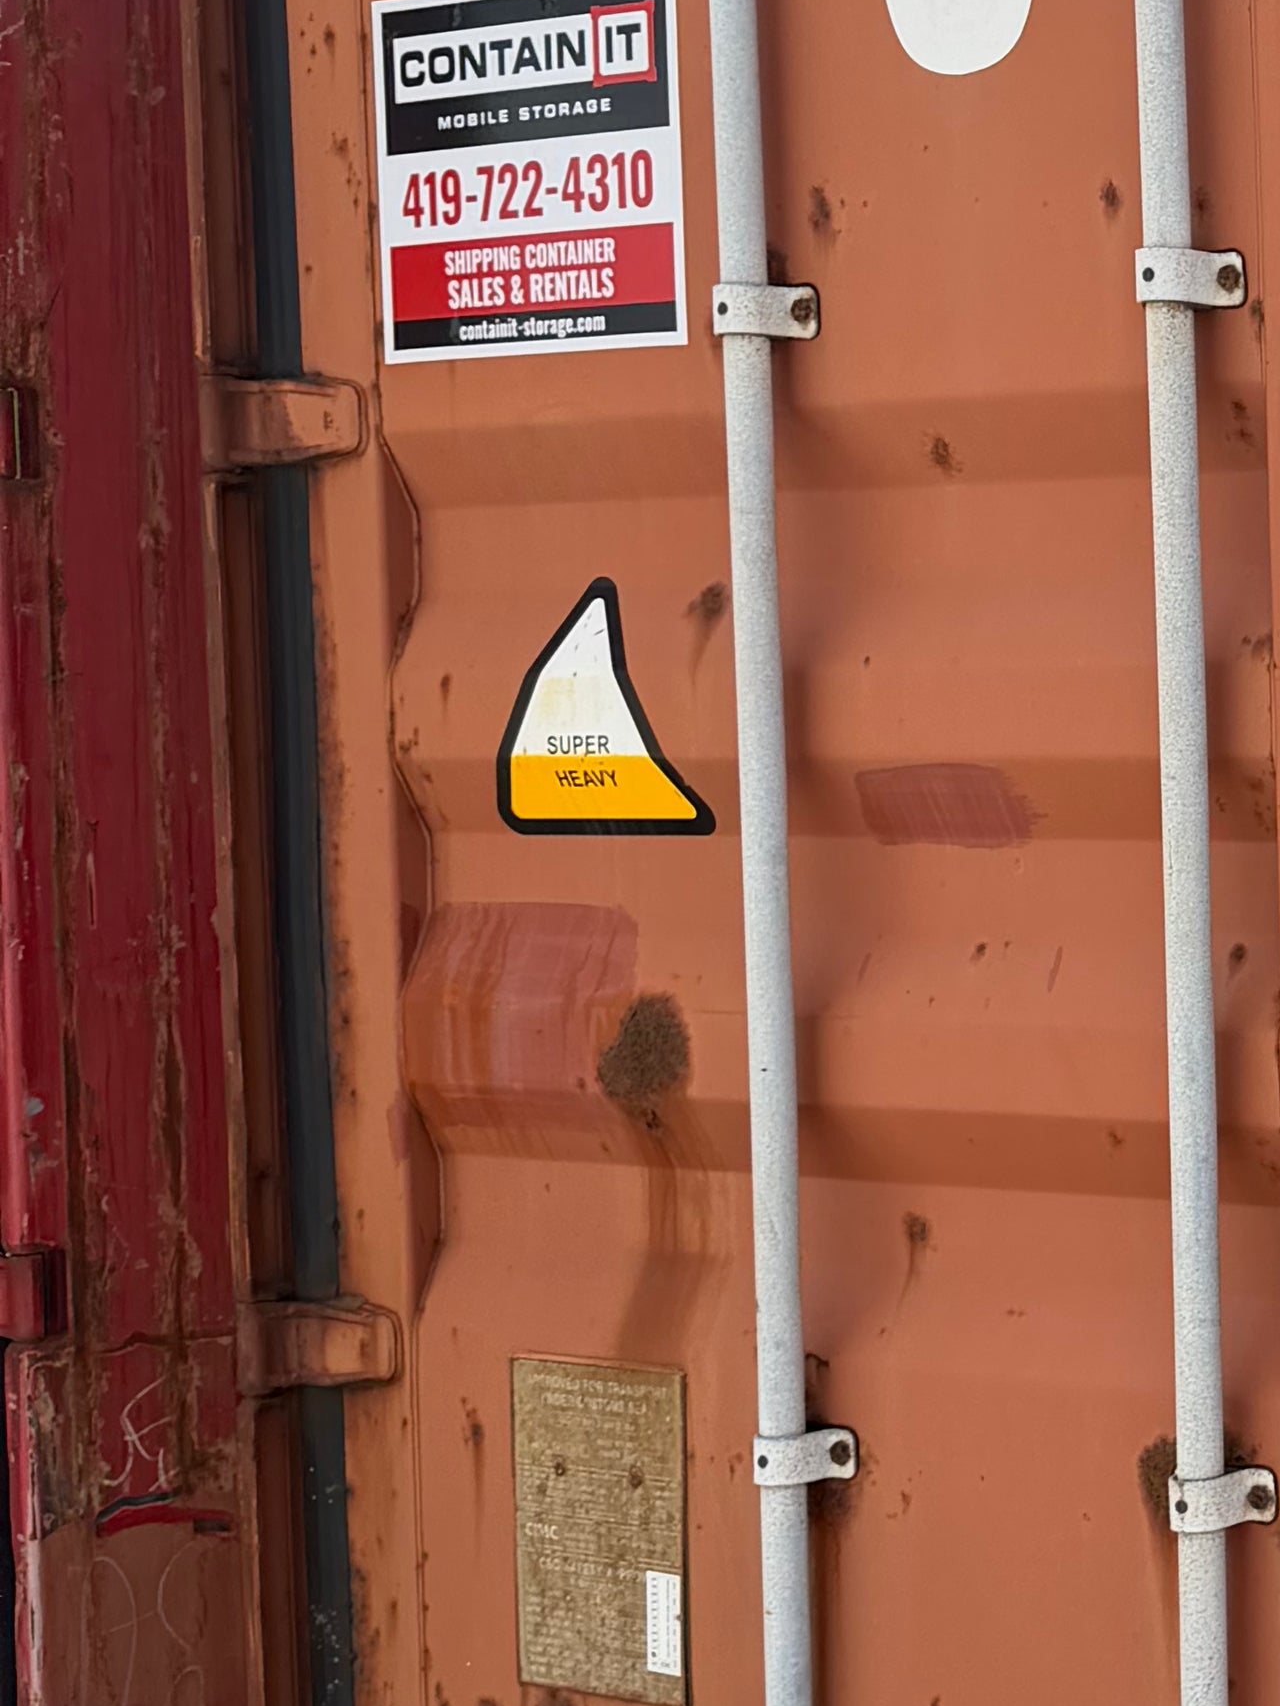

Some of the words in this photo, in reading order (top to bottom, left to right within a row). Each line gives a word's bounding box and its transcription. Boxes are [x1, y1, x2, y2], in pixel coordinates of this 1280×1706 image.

[399, 26, 587, 88] CONTAIN
[606, 24, 640, 62] IT
[438, 109, 509, 131] MOBILE
[519, 98, 612, 121] STORAGE
[403, 151, 656, 229] 419-722-4310
[444, 245, 521, 276] SHIPPING
[524, 237, 616, 269] CONTAINER
[447, 276, 505, 309] SALES
[510, 275, 525, 305] &
[530, 268, 614, 303] RENTALS
[459, 315, 606, 341] containit-storage.com
[547, 735, 610, 755] SUPER
[555, 770, 617, 787] HEAVY
